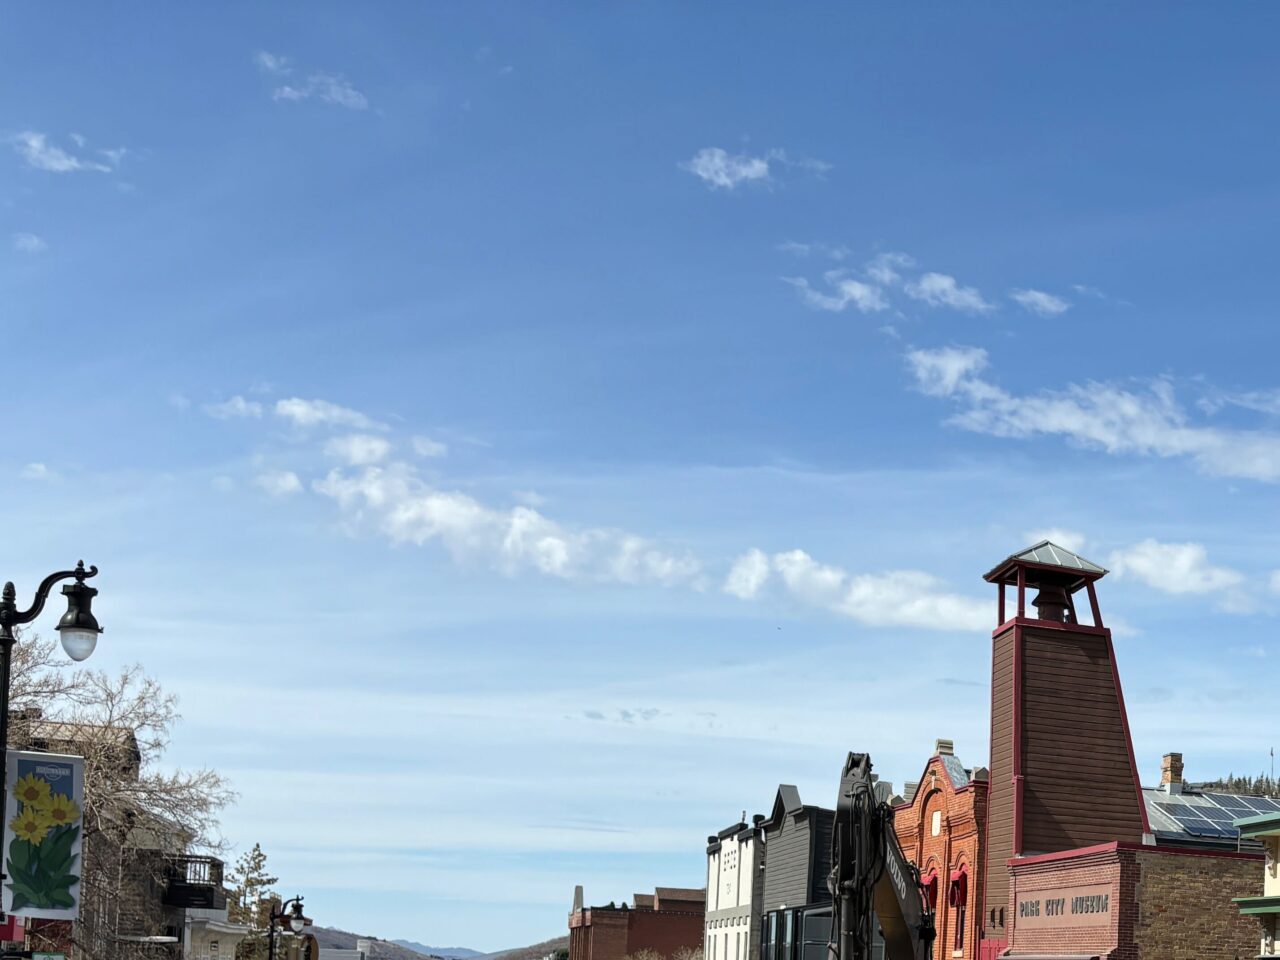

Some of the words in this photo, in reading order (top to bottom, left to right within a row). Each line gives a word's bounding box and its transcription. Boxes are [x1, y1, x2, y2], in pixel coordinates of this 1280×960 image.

[886, 841, 907, 900] VOLVO
[1020, 900, 1040, 918] PARK
[1045, 898, 1065, 916] CITY
[1071, 894, 1109, 914] MUSEUM
